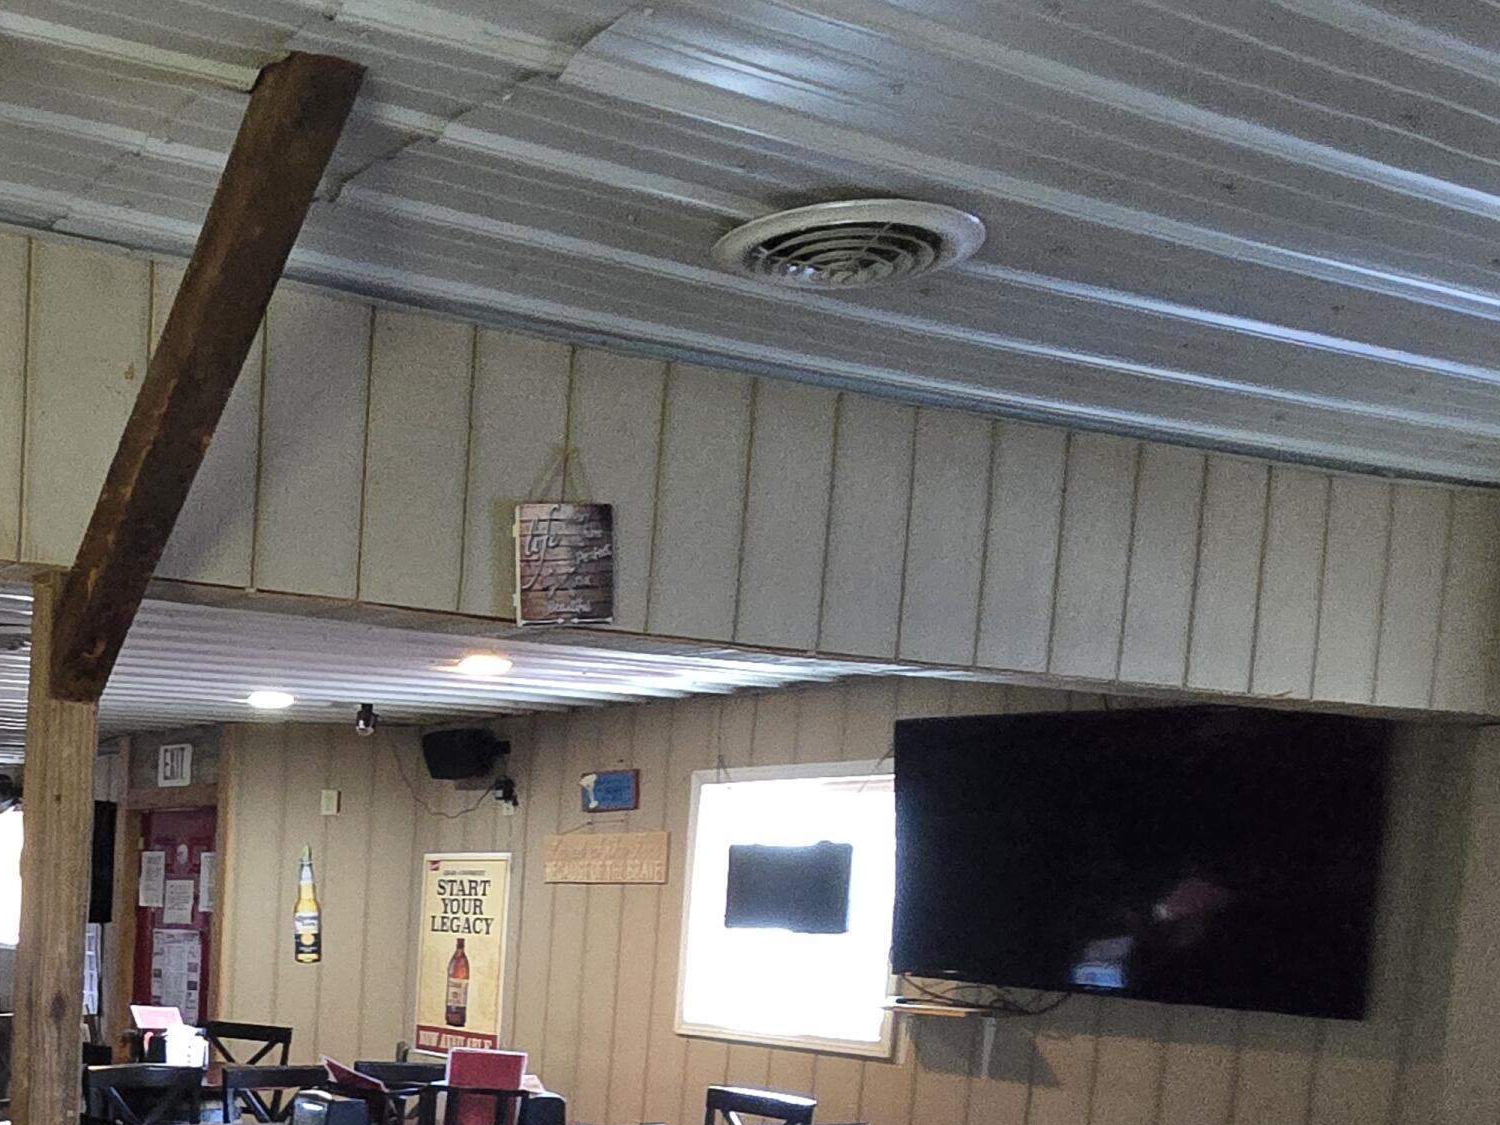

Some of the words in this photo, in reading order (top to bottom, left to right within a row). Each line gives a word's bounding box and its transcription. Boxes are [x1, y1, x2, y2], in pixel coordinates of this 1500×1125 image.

[164, 747, 185, 780] EXIT
[437, 879, 491, 897] START
[441, 898, 484, 915] YOUR
[430, 916, 494, 935] LEGACY
